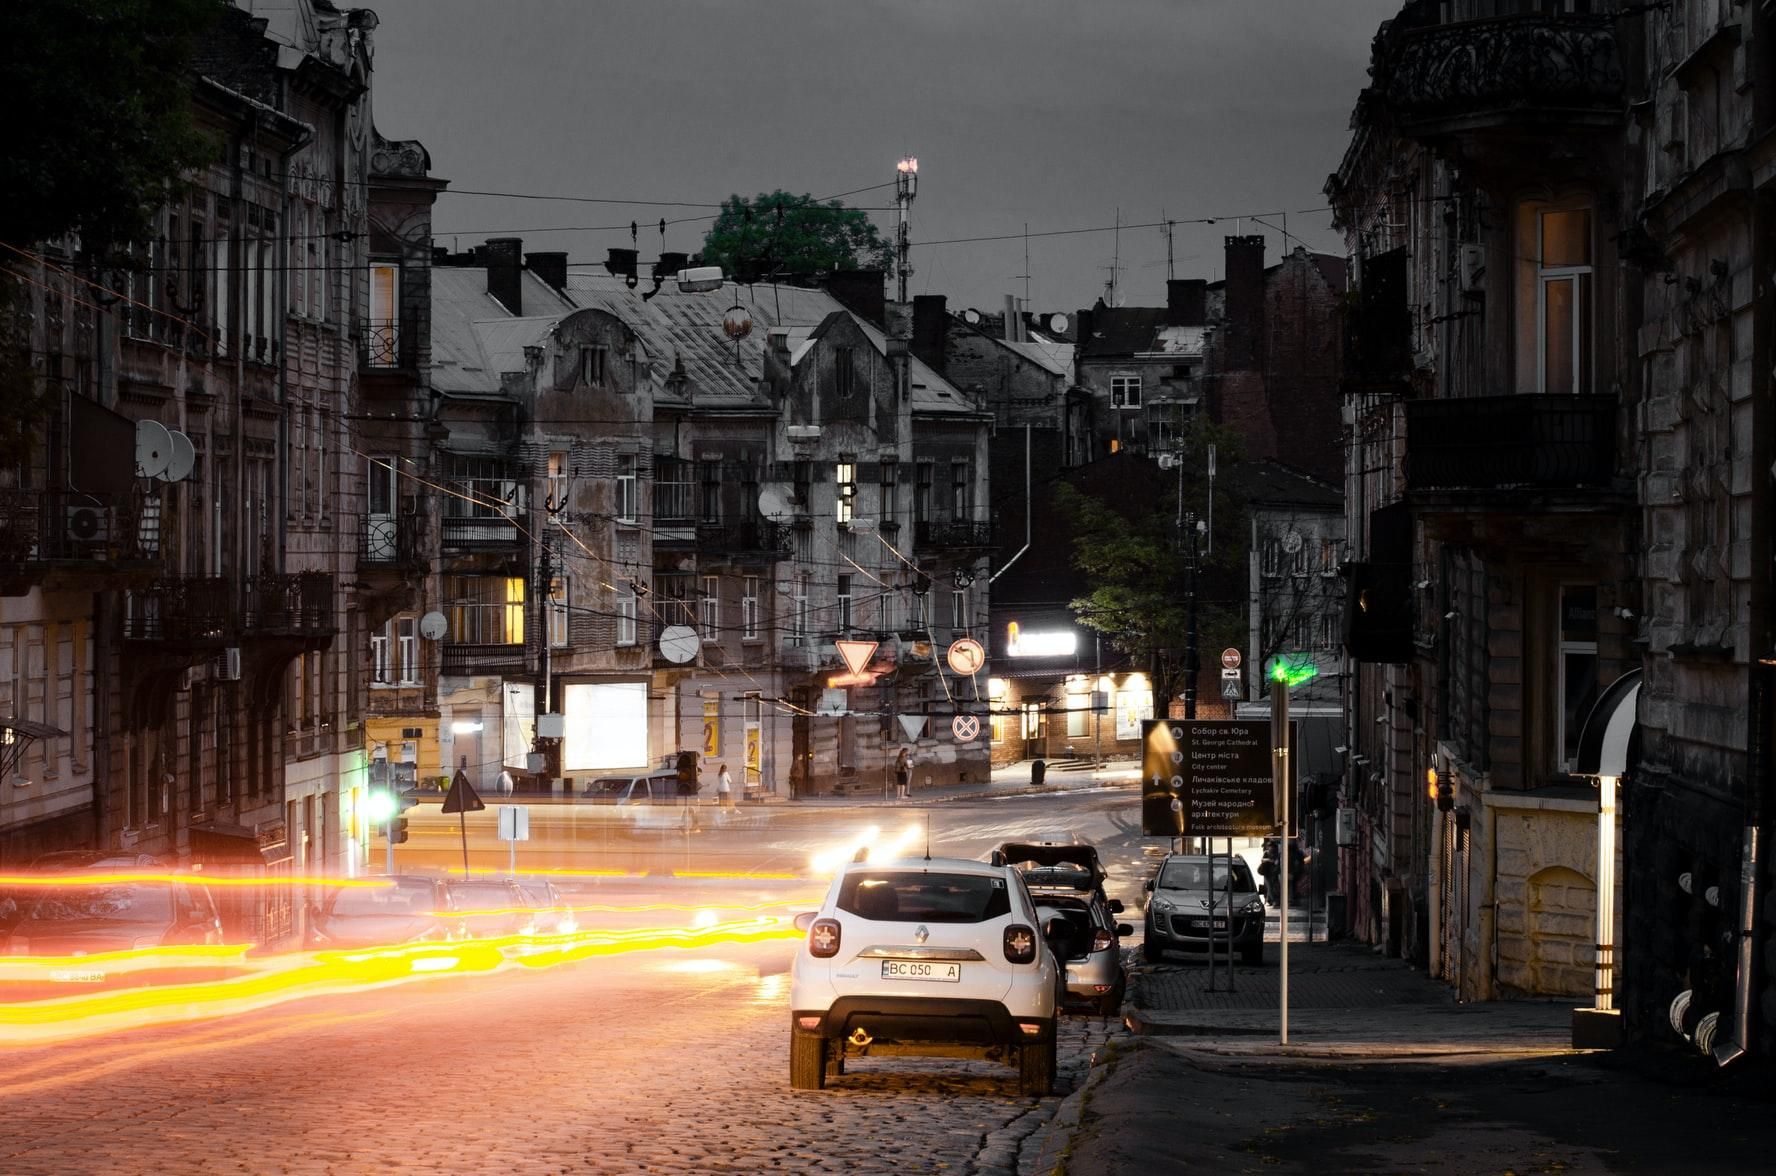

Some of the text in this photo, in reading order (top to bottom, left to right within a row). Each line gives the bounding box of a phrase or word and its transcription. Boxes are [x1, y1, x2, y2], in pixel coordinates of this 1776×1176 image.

[1191, 727, 1217, 736] Собор
[1231, 727, 1249, 736] Юра
[1202, 739, 1226, 747] George
[1191, 751, 1240, 760] Центр міста
[1191, 763, 1205, 771] City
[1191, 775, 1273, 784] Личаківське кладов
[1191, 787, 1252, 795] Lychakiv Cemetery
[1191, 799, 1255, 808] Музей народної
[1191, 810, 1239, 819] архітектури
[889, 963, 956, 977] BC 050 A
